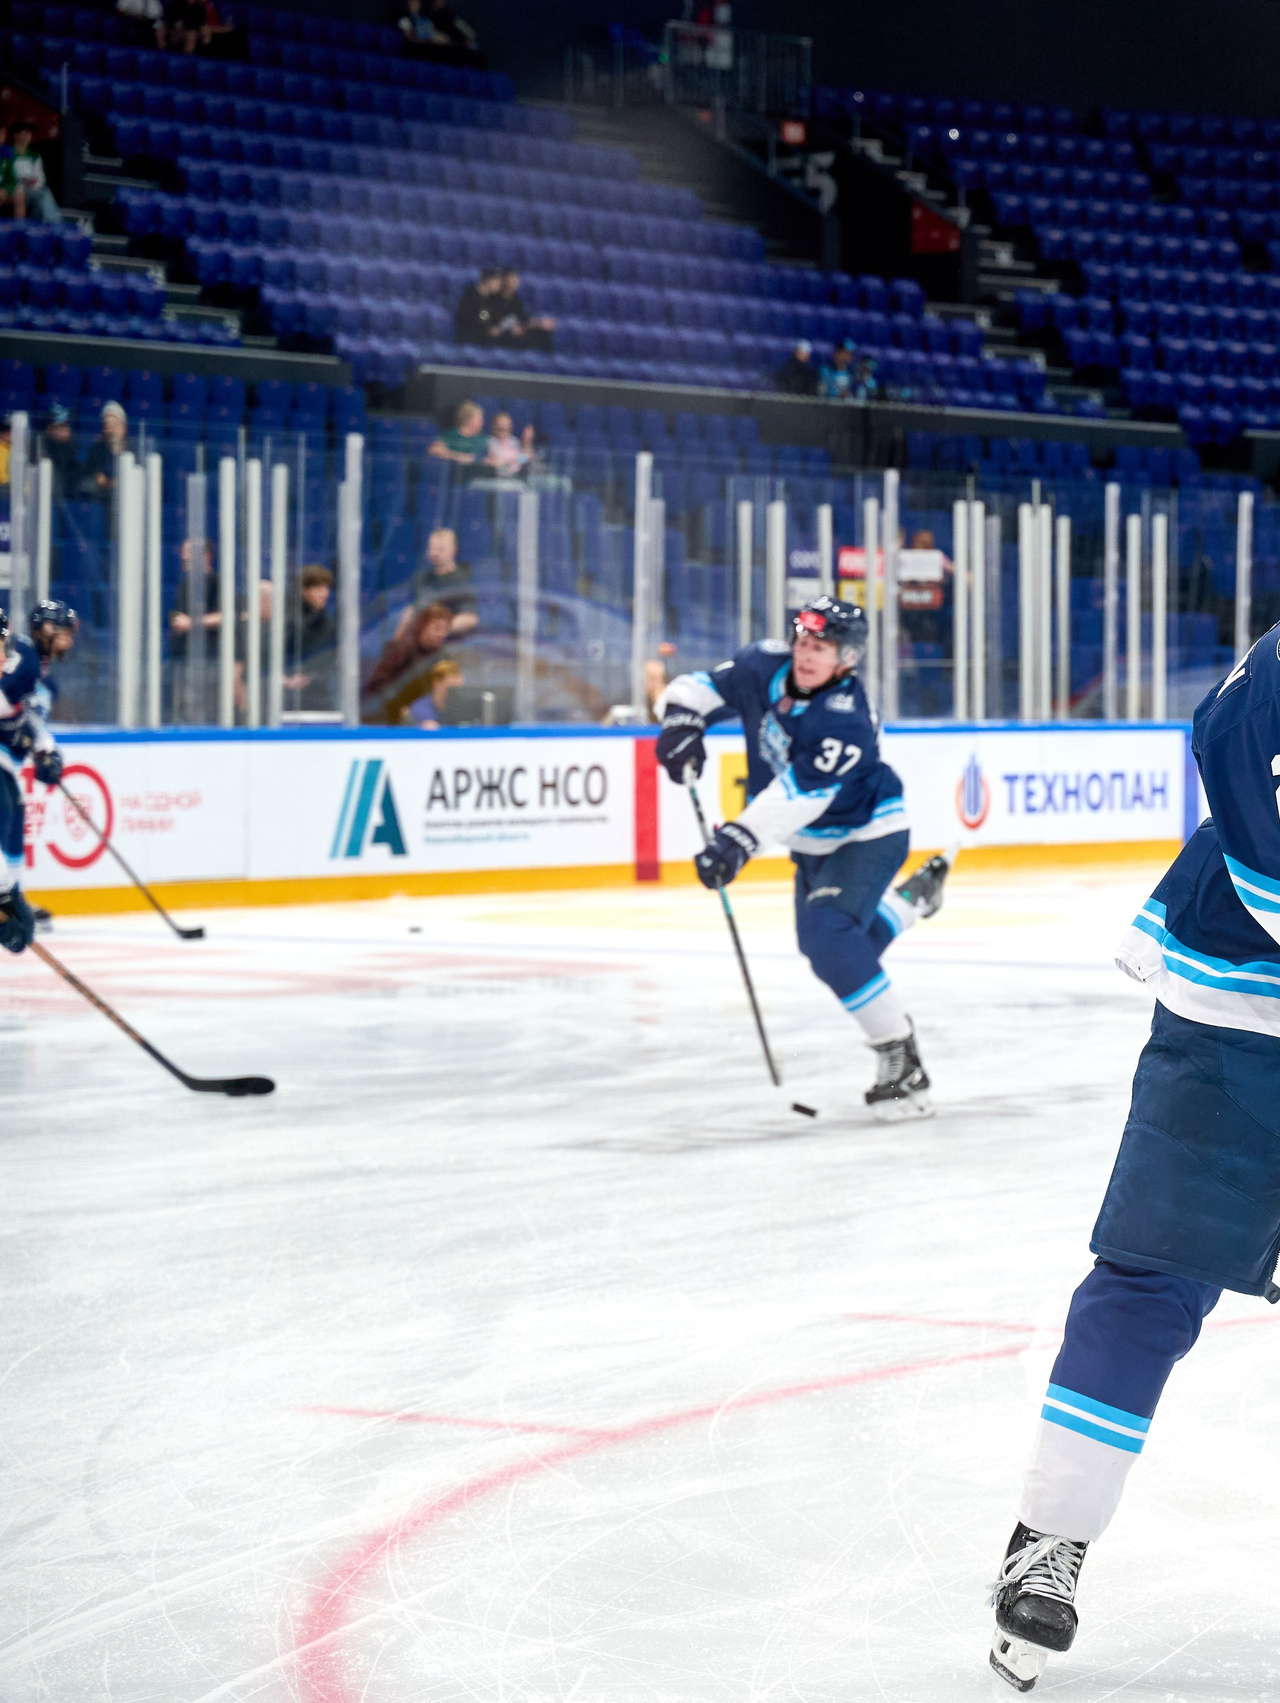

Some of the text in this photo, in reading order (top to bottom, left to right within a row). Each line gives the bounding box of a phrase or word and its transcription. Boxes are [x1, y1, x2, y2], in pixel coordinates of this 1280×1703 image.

[813, 737, 862, 777] 37
[425, 764, 608, 811] АРЖС НСО
[1003, 772, 1168, 814] ТЕХНОПАН
